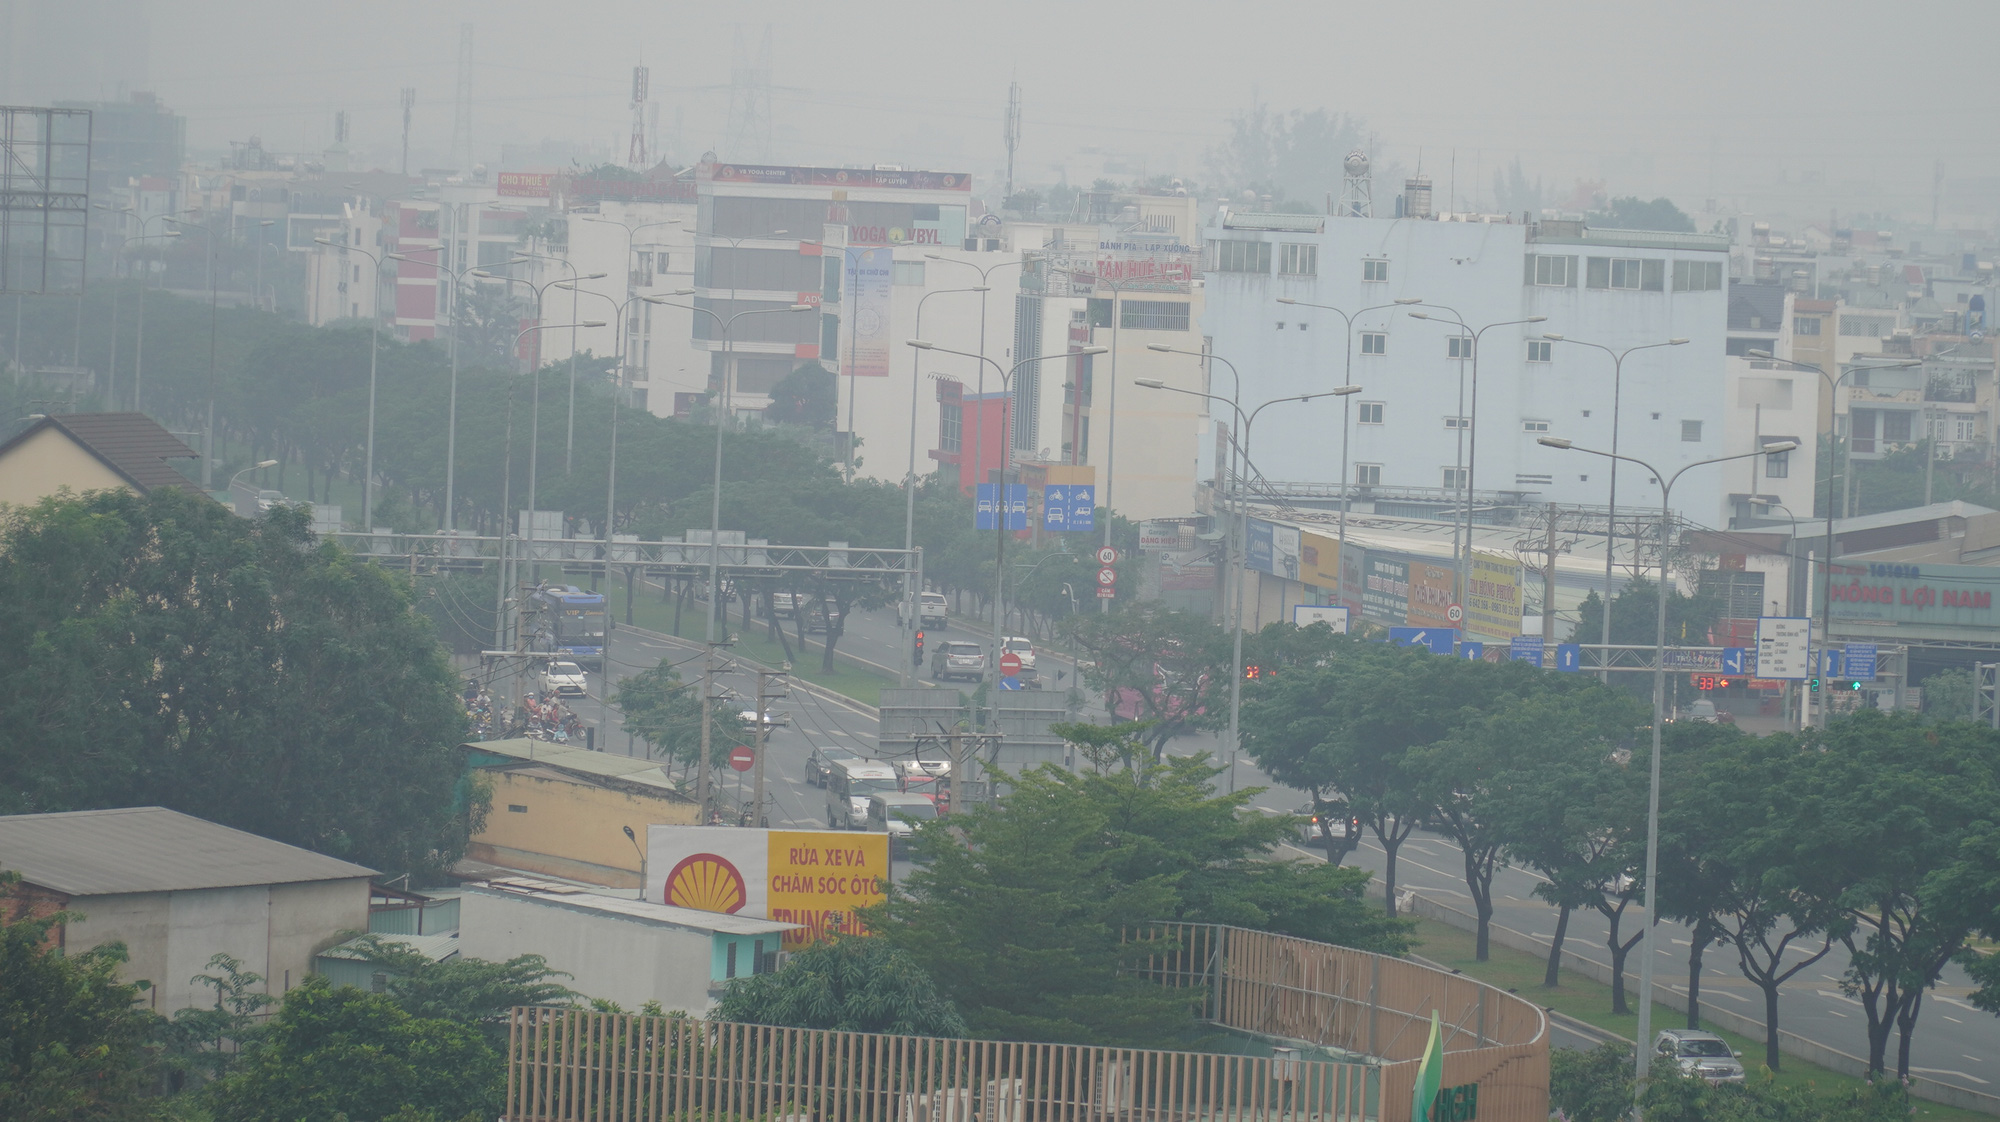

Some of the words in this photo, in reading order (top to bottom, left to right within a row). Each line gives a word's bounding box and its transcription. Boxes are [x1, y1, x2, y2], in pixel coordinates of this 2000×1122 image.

[501, 175, 519, 185] CHO
[520, 175, 542, 187] THUÊ
[851, 225, 887, 243] YOGA
[906, 228, 942, 245] VBYL
[1100, 239, 1122, 251] BÁNH
[1149, 529, 1169, 537] Garage
[1103, 551, 1112, 561] 60
[1900, 585, 1936, 611] LỢI
[1941, 590, 1991, 609] NAM
[1450, 608, 1460, 619] 60
[1698, 677, 1715, 690] 33
[1811, 679, 1820, 692] 2
[790, 842, 820, 867] RỬA
[824, 848, 843, 867] XE
[844, 845, 866, 867] VÀ
[772, 872, 815, 894] CHĂM
[818, 872, 847, 895] SÓC
[851, 873, 882, 896] ÔTÔ
[773, 908, 834, 946] TRUNG
